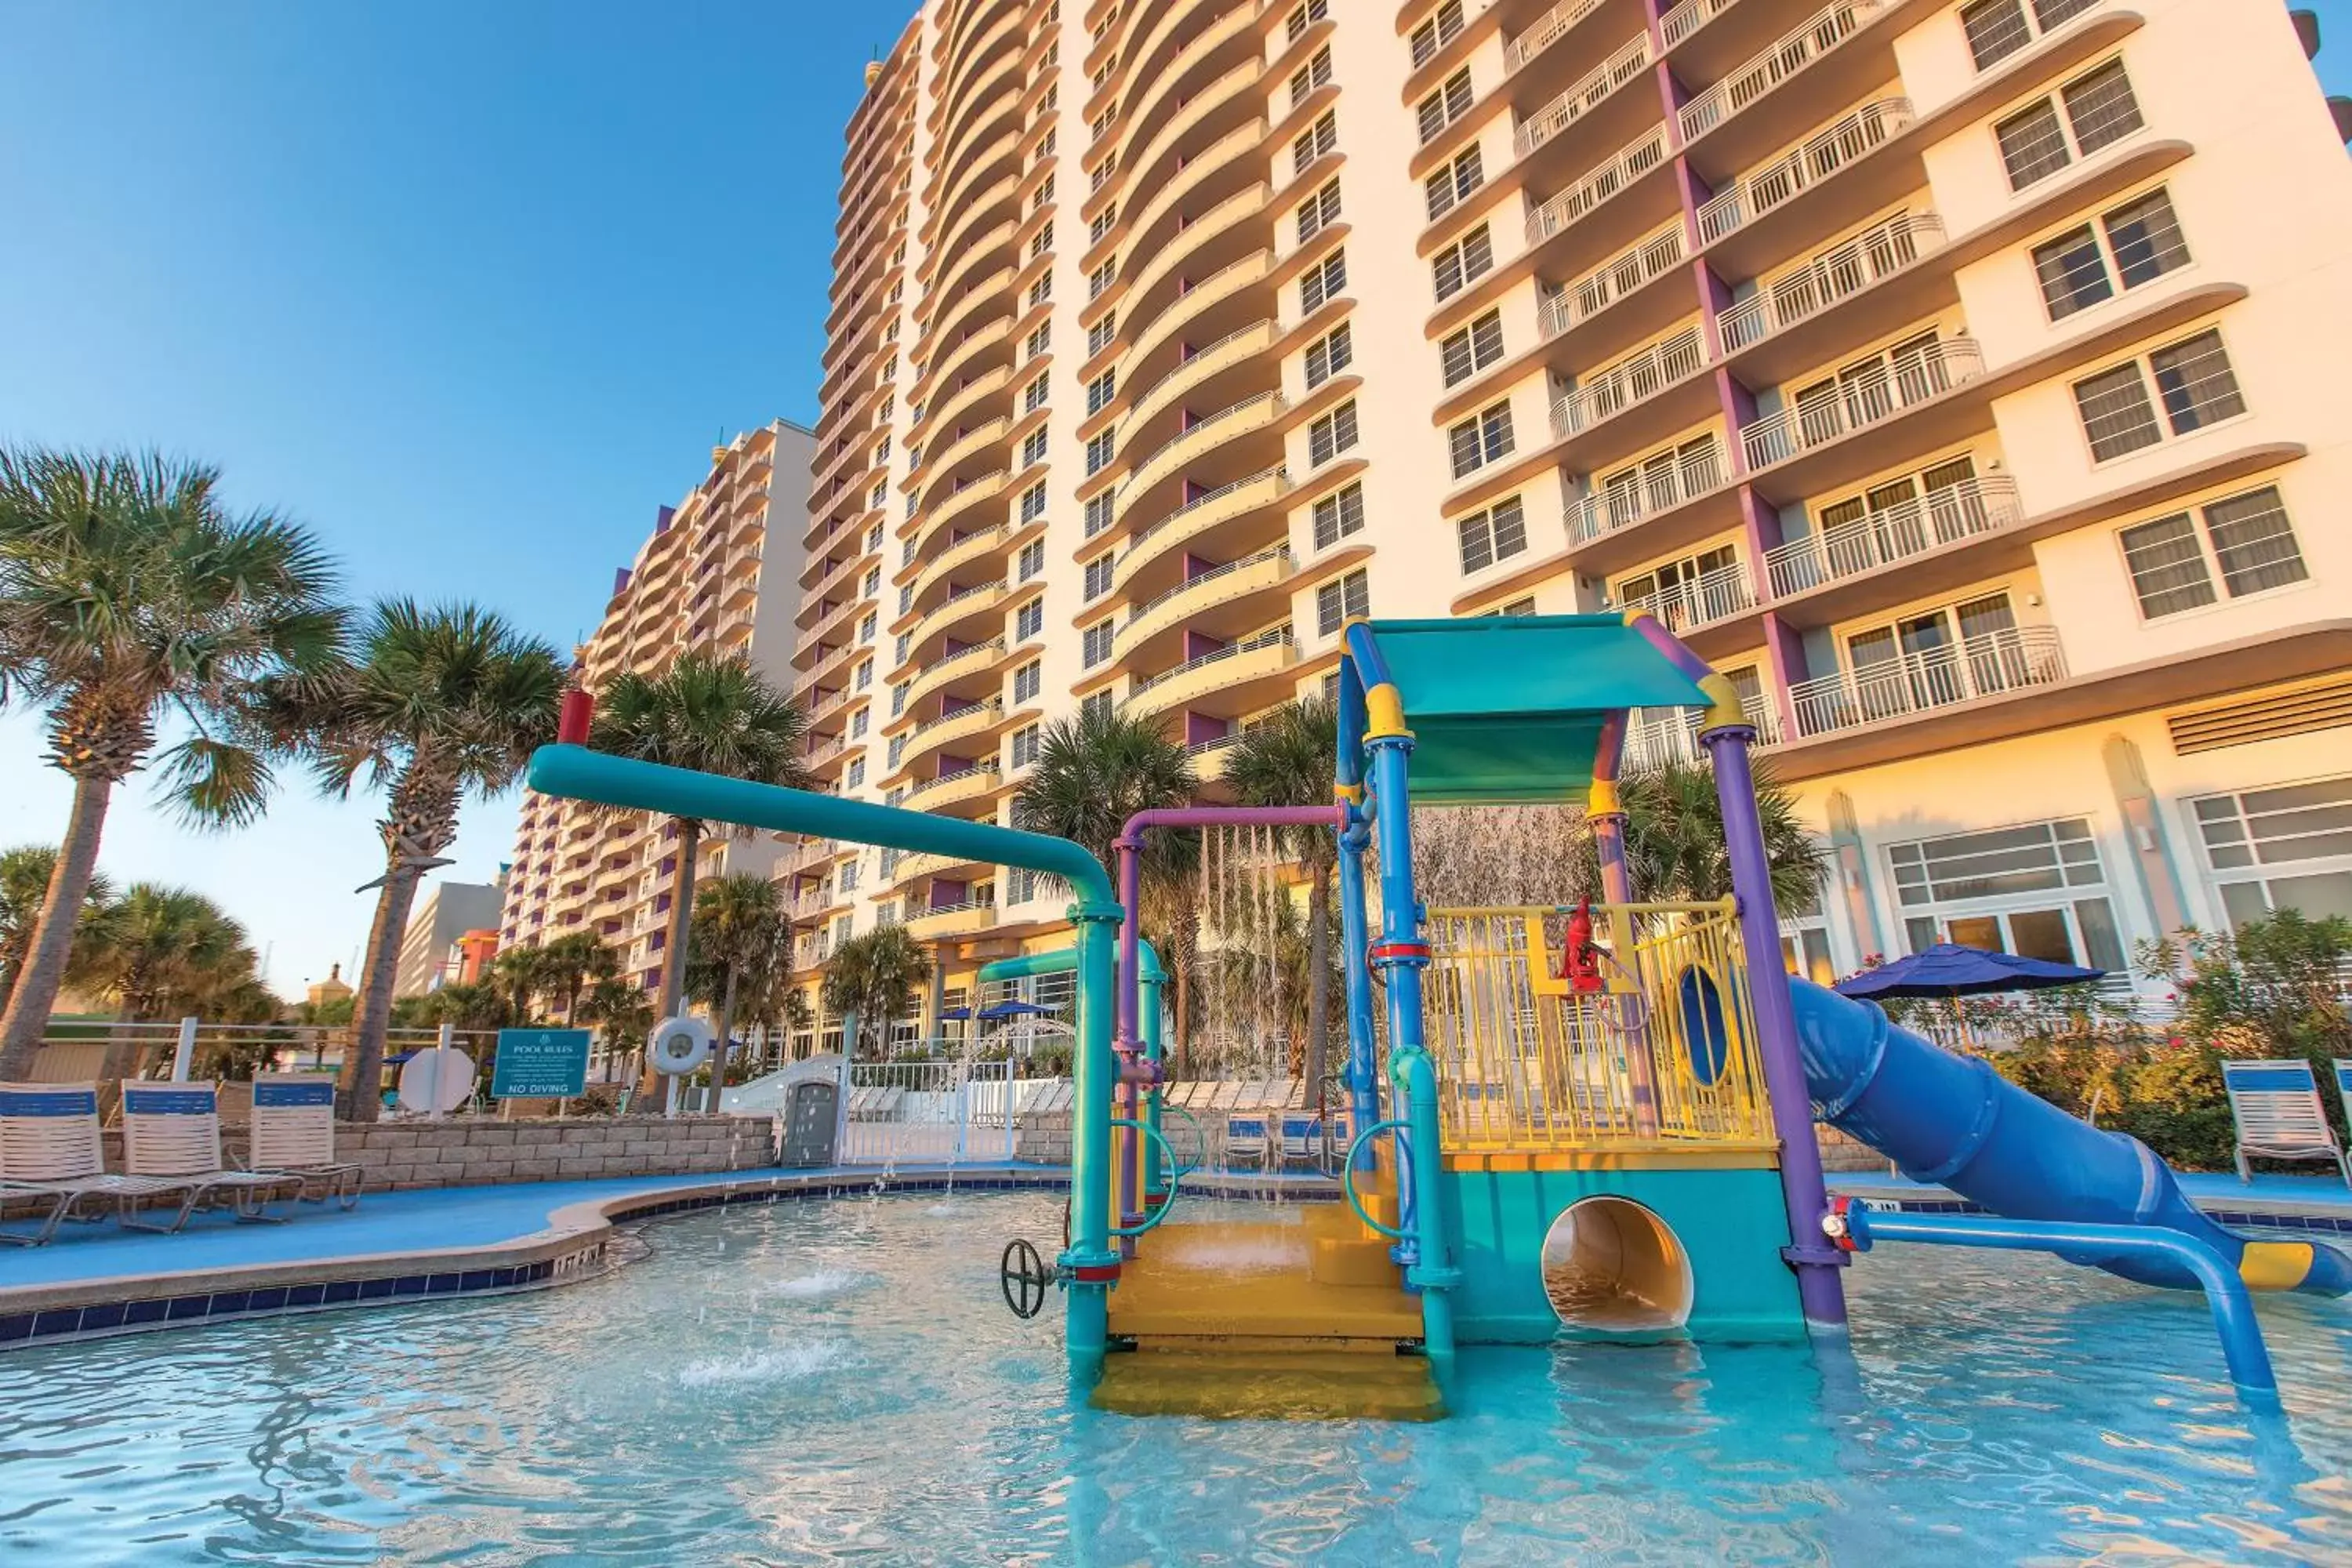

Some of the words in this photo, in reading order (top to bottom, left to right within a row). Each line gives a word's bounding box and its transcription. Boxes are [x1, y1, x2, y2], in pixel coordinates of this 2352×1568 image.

[514, 1045, 541, 1054] POOL
[508, 1085, 526, 1094] NO
[529, 1084, 568, 1093] DIVING
